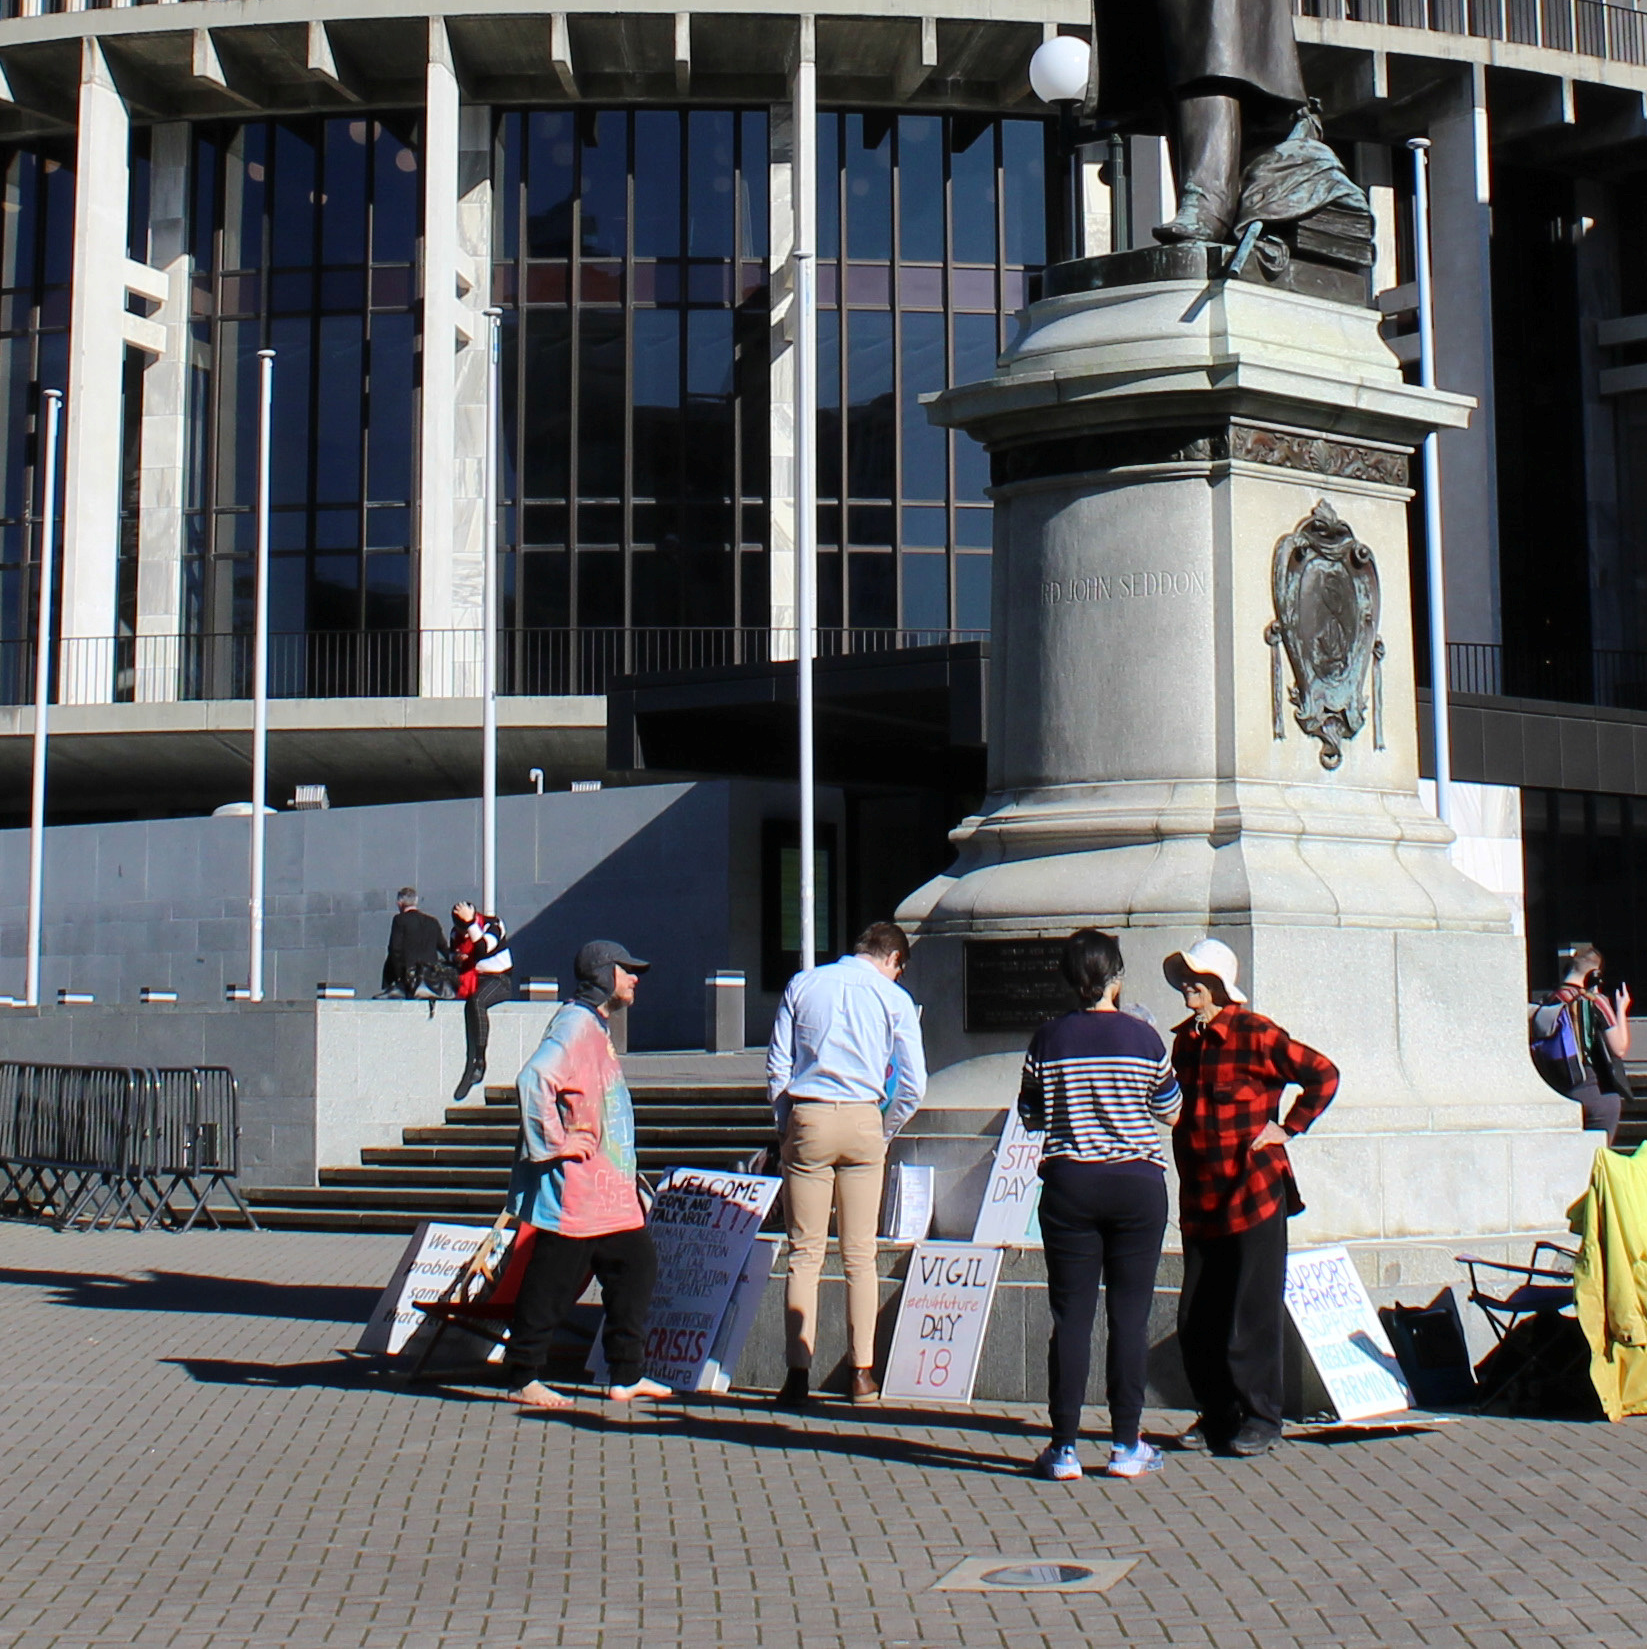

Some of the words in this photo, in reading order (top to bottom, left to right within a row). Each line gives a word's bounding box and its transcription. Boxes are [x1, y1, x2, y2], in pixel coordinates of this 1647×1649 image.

[1041, 582, 1062, 605] RD
[1066, 576, 1112, 604] JOHN
[1119, 570, 1205, 600] SEDDON
[1000, 1143, 1040, 1171] STR
[667, 1171, 767, 1202] WELCOME
[992, 1175, 1036, 1204] DAY
[652, 1208, 679, 1224] TALK
[679, 1210, 714, 1228] ABOUT
[657, 1194, 688, 1209] COME
[689, 1198, 714, 1212] AND
[427, 1233, 452, 1250] We
[452, 1238, 479, 1253] can
[920, 1255, 987, 1288] VIGIL
[1284, 1256, 1353, 1292] SUPPORT
[407, 1286, 442, 1301] sam
[1288, 1282, 1363, 1316] FARMERS
[383, 1306, 416, 1325] that
[920, 1313, 964, 1342] DAY
[1300, 1307, 1372, 1339] SUPPORT
[643, 1327, 708, 1364] CRISIS
[915, 1348, 953, 1388] 18
